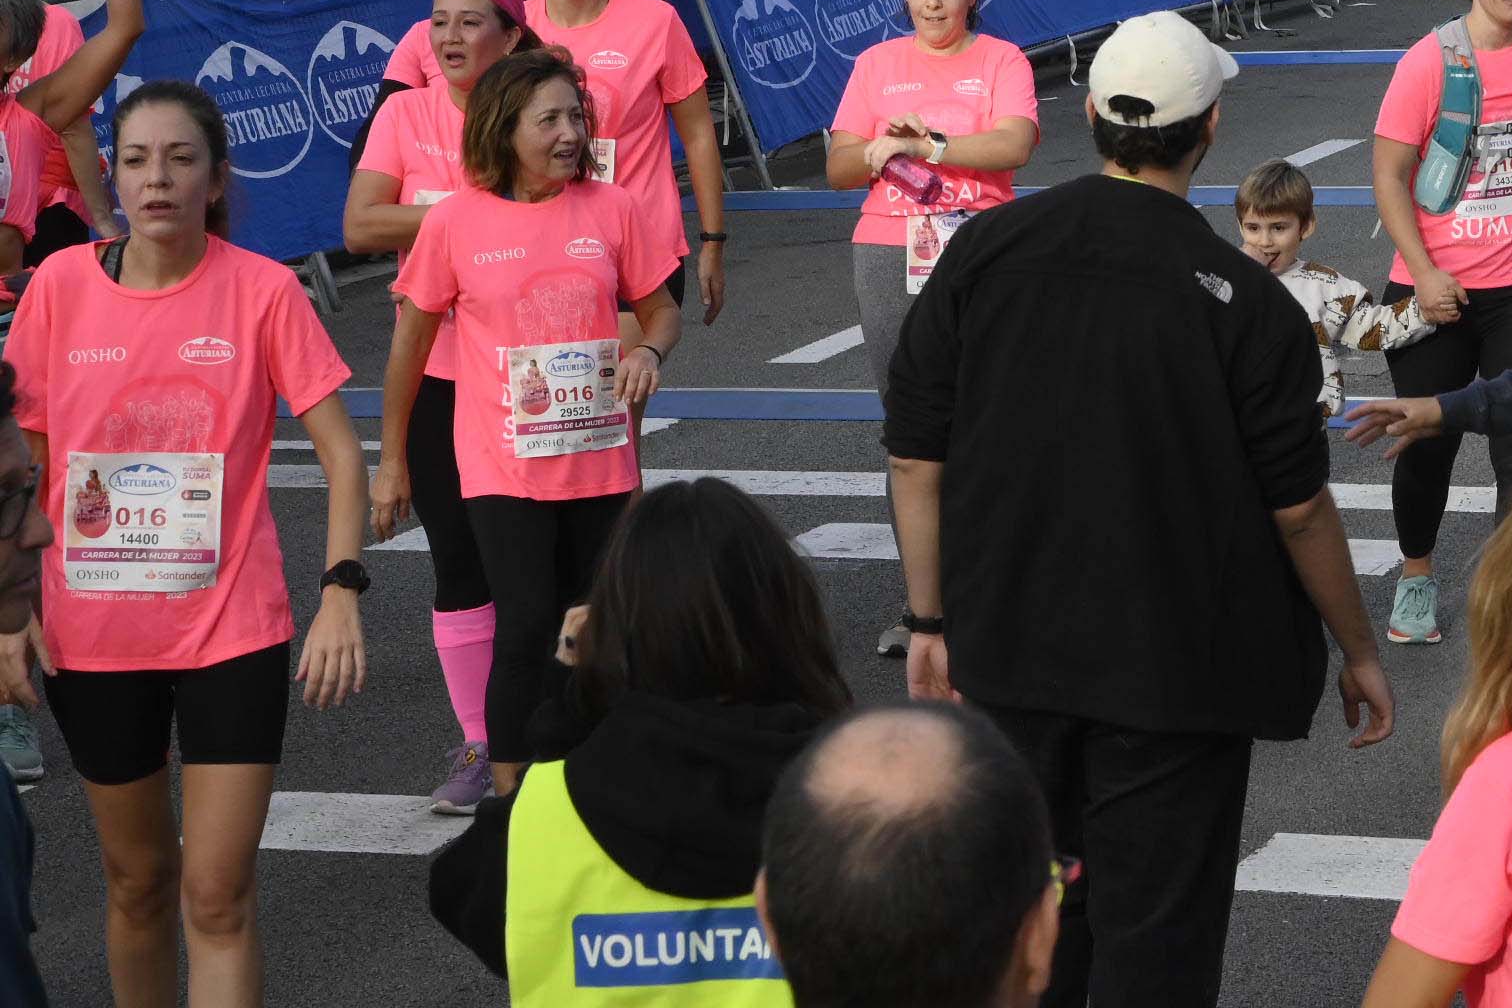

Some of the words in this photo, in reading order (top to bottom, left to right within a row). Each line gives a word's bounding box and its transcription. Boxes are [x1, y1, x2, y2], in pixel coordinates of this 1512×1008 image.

[883, 81, 922, 96] OYSHO
[224, 100, 306, 149] STURIANA
[474, 247, 526, 266] OYSHO
[68, 347, 127, 365] OYSHO
[181, 345, 233, 359] ASTURIANA
[550, 361, 593, 373] ASTURIANA
[554, 385, 594, 403] 016
[560, 406, 591, 418] 29525
[528, 423, 563, 432] CARRERA
[584, 419, 605, 427] MUJER
[526, 438, 564, 450] OYSHO
[114, 475, 171, 489] ASTURIANA
[183, 472, 211, 480] SUMA
[115, 507, 167, 526] 016
[120, 533, 159, 545] 14400
[81, 551, 120, 559] CARRERA
[149, 552, 180, 560] MUJER
[76, 569, 120, 580] OYSHO
[157, 571, 206, 581] Santander
[580, 927, 771, 967] VOLUNTA
